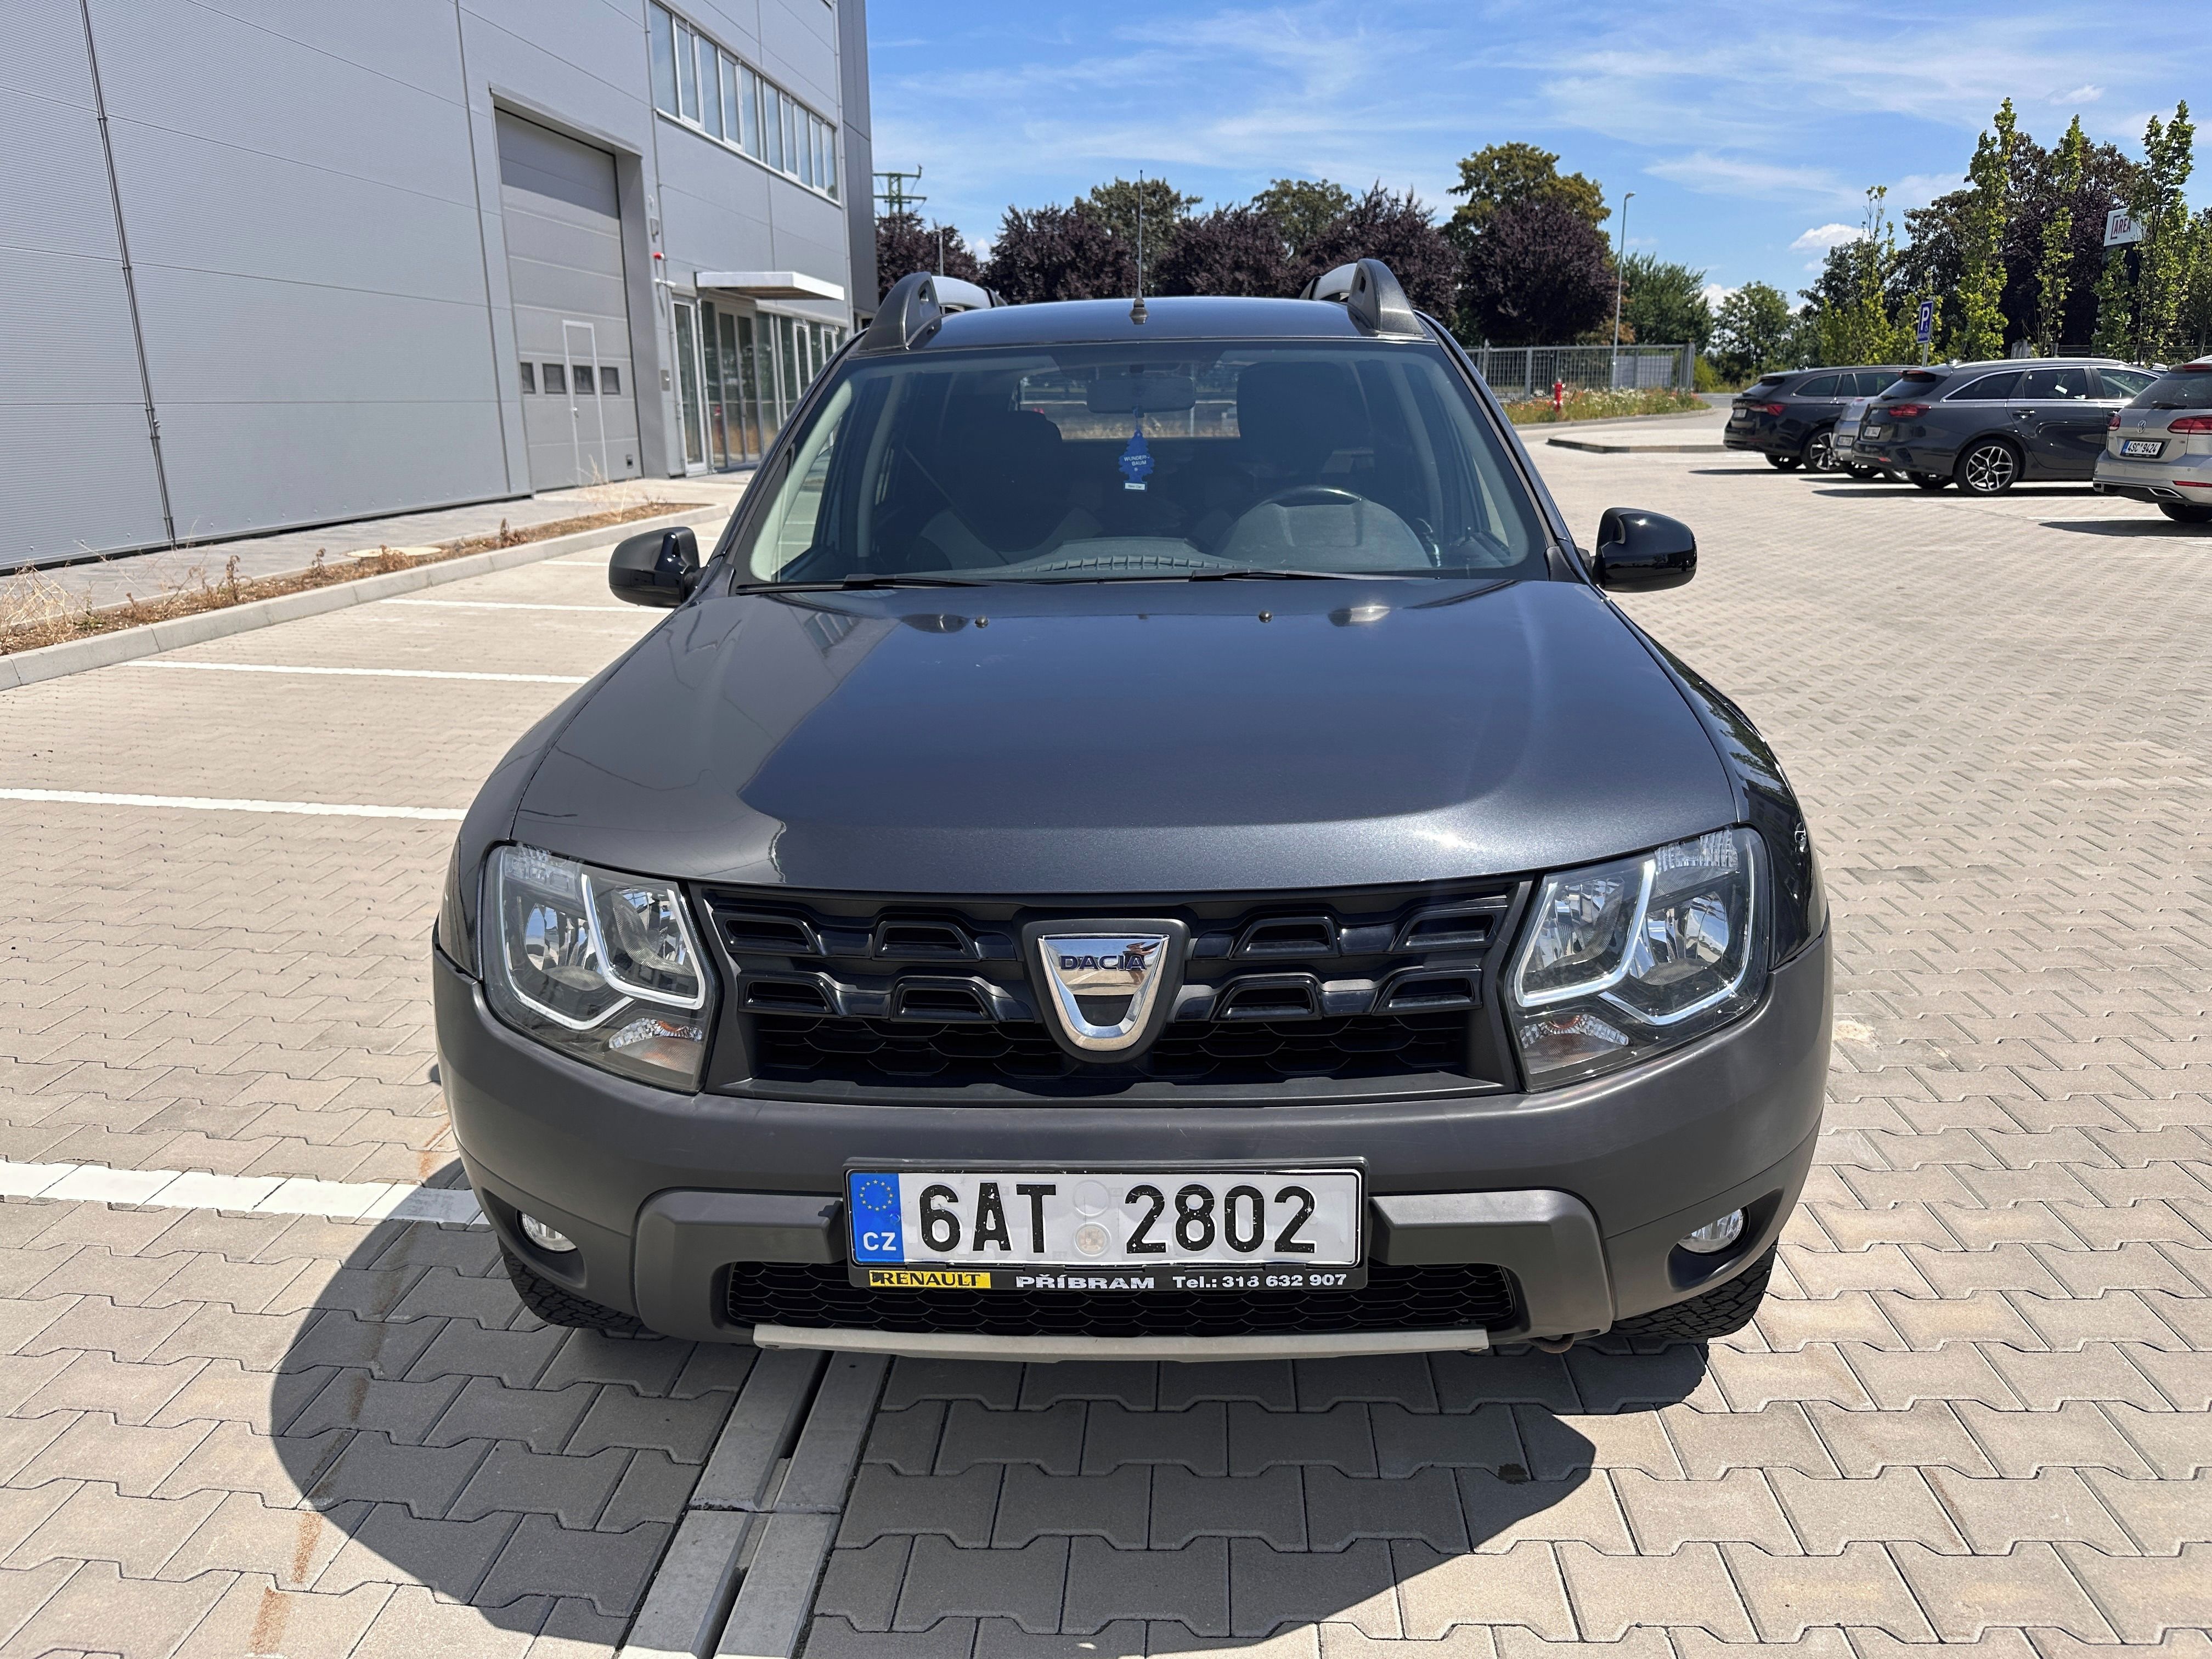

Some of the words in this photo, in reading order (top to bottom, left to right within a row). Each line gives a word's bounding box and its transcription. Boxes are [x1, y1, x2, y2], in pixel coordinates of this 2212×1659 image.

[1921, 307, 1929, 330] P
[2128, 443, 2140, 453] 4SC
[2142, 443, 2158, 453] 9424
[1060, 955, 1147, 970] DACIA
[919, 1182, 1057, 1252] 6AT
[1124, 1184, 1317, 1254] 2802
[863, 1232, 896, 1251] CZ
[880, 1272, 980, 1286] RENAULT
[1015, 1274, 1154, 1289] PŘÍBRAM
[1172, 1276, 1217, 1288] Tel.:
[1266, 1275, 1303, 1286] 632
[1309, 1274, 1347, 1285] 907
